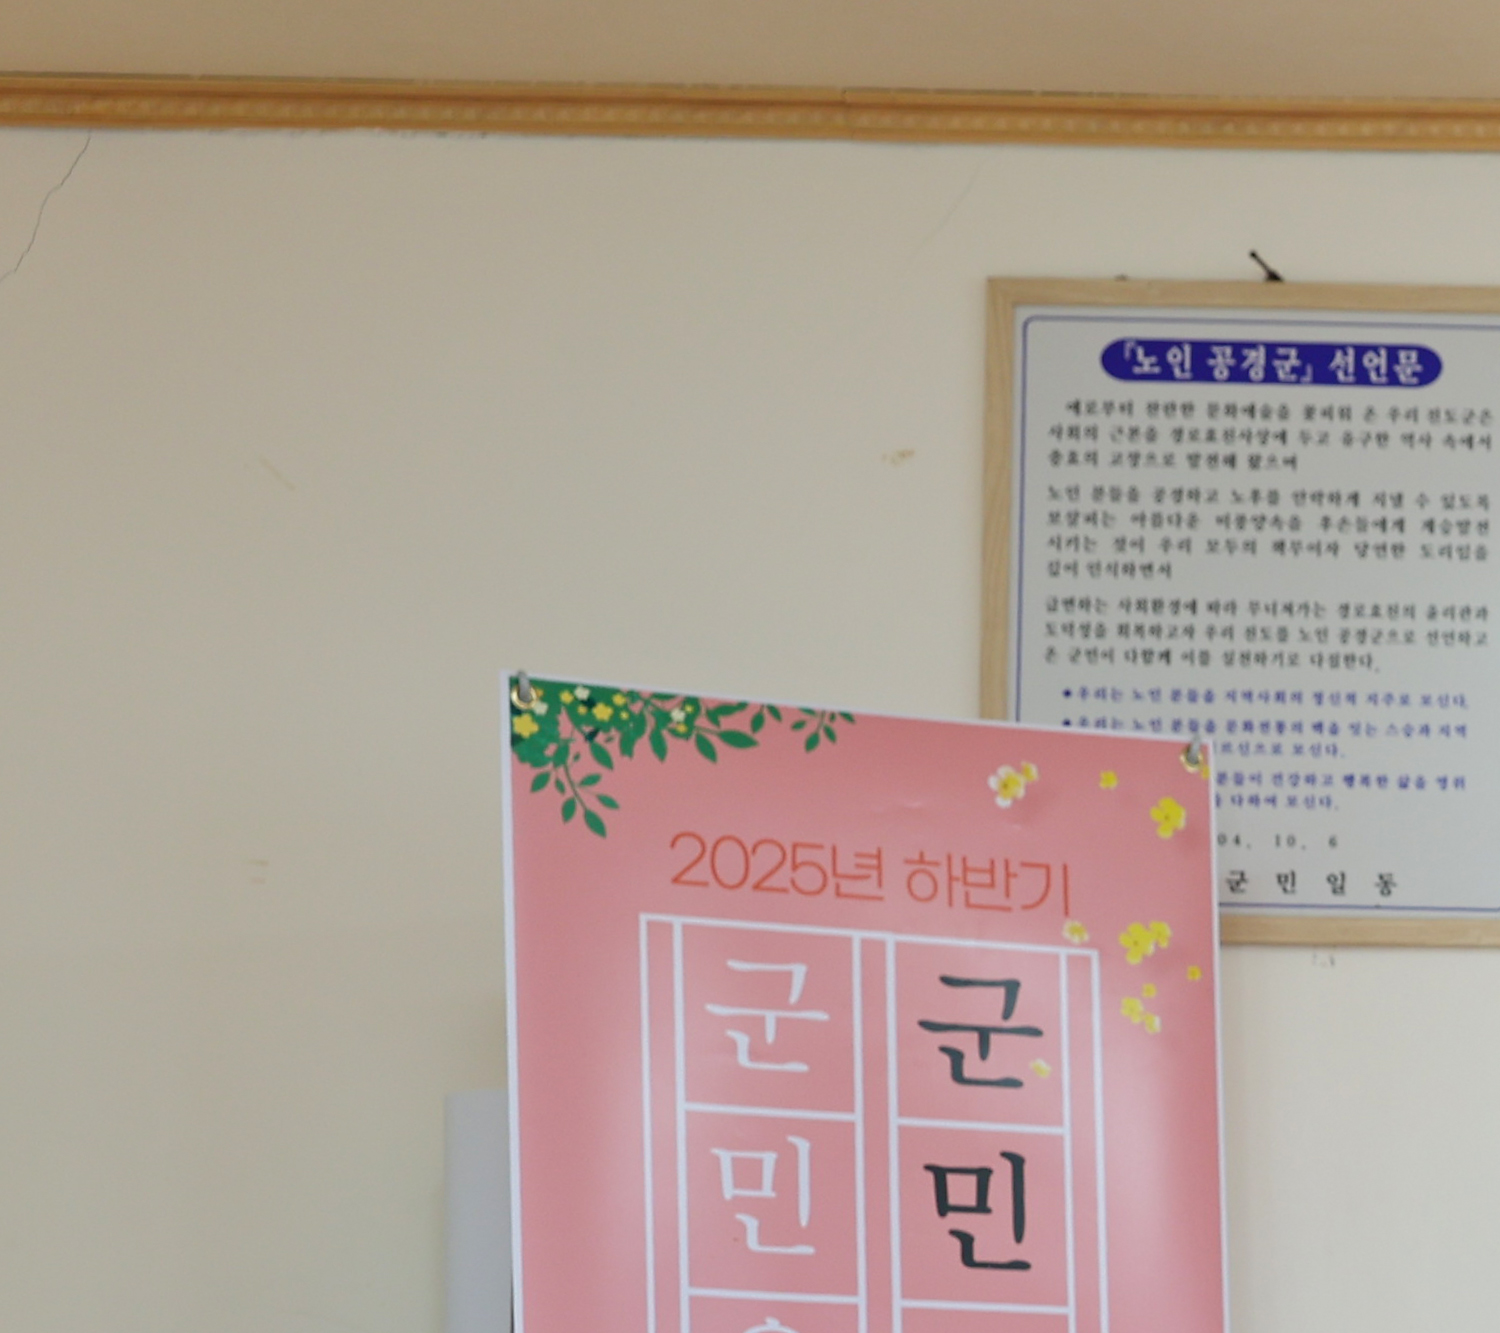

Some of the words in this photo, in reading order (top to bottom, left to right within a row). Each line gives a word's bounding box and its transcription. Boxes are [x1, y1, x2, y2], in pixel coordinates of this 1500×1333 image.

[1328, 347, 1424, 385] 선언문
[669, 830, 885, 902] 2025년
[904, 848, 1073, 917] 하반기
